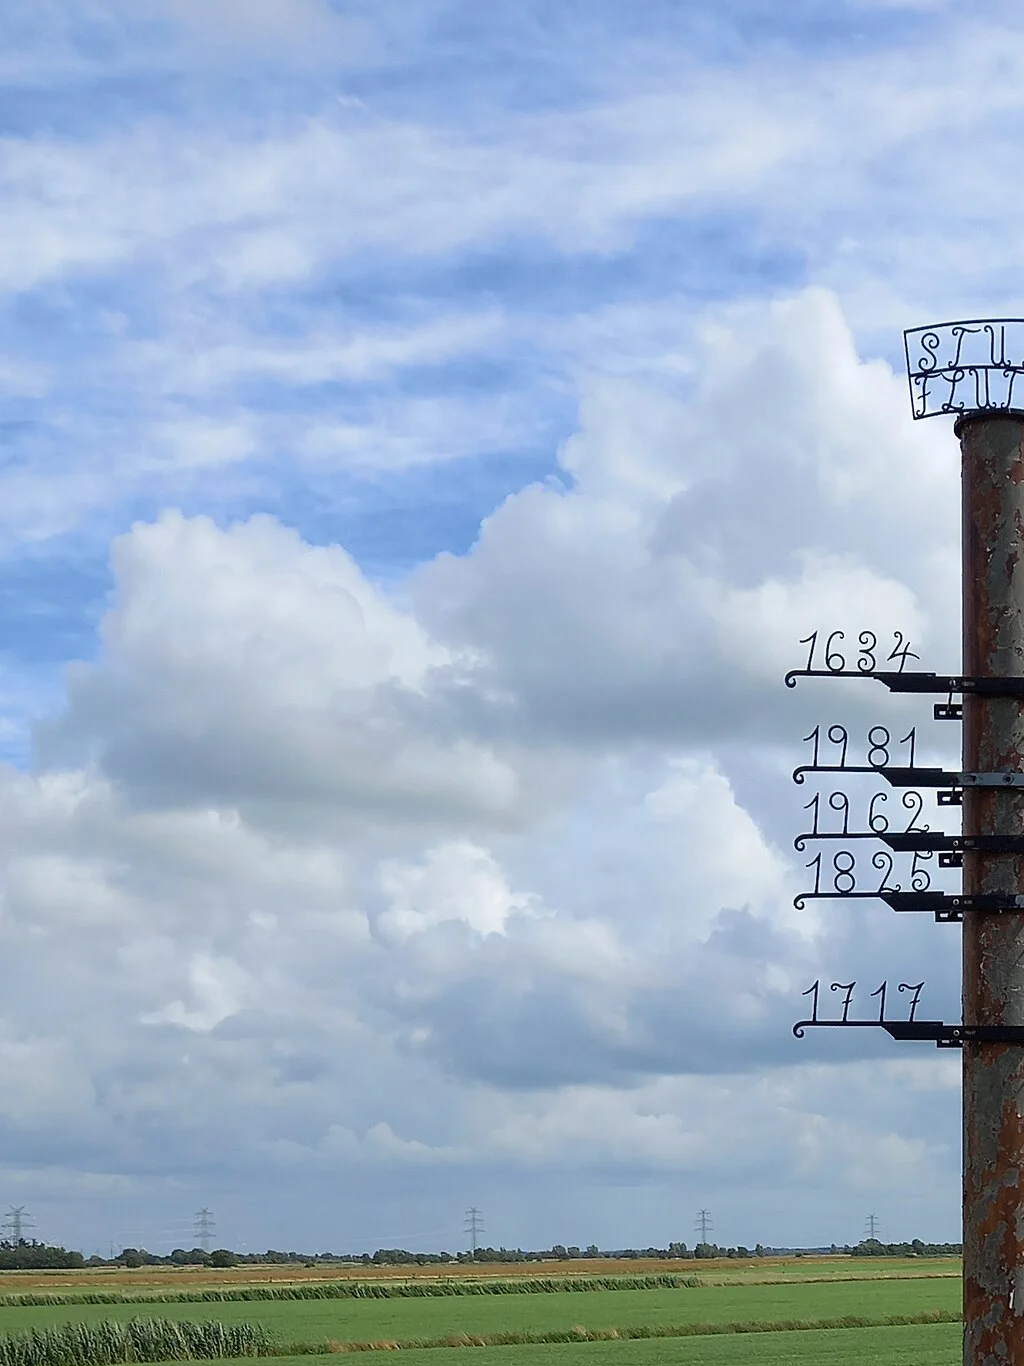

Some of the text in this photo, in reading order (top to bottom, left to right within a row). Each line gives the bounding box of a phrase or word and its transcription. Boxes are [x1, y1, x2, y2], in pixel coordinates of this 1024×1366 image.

[798, 629, 922, 674] 1634
[802, 724, 917, 769] 1981
[803, 789, 930, 834] 1962
[804, 850, 934, 894] 1825
[801, 979, 926, 1023] 1717
